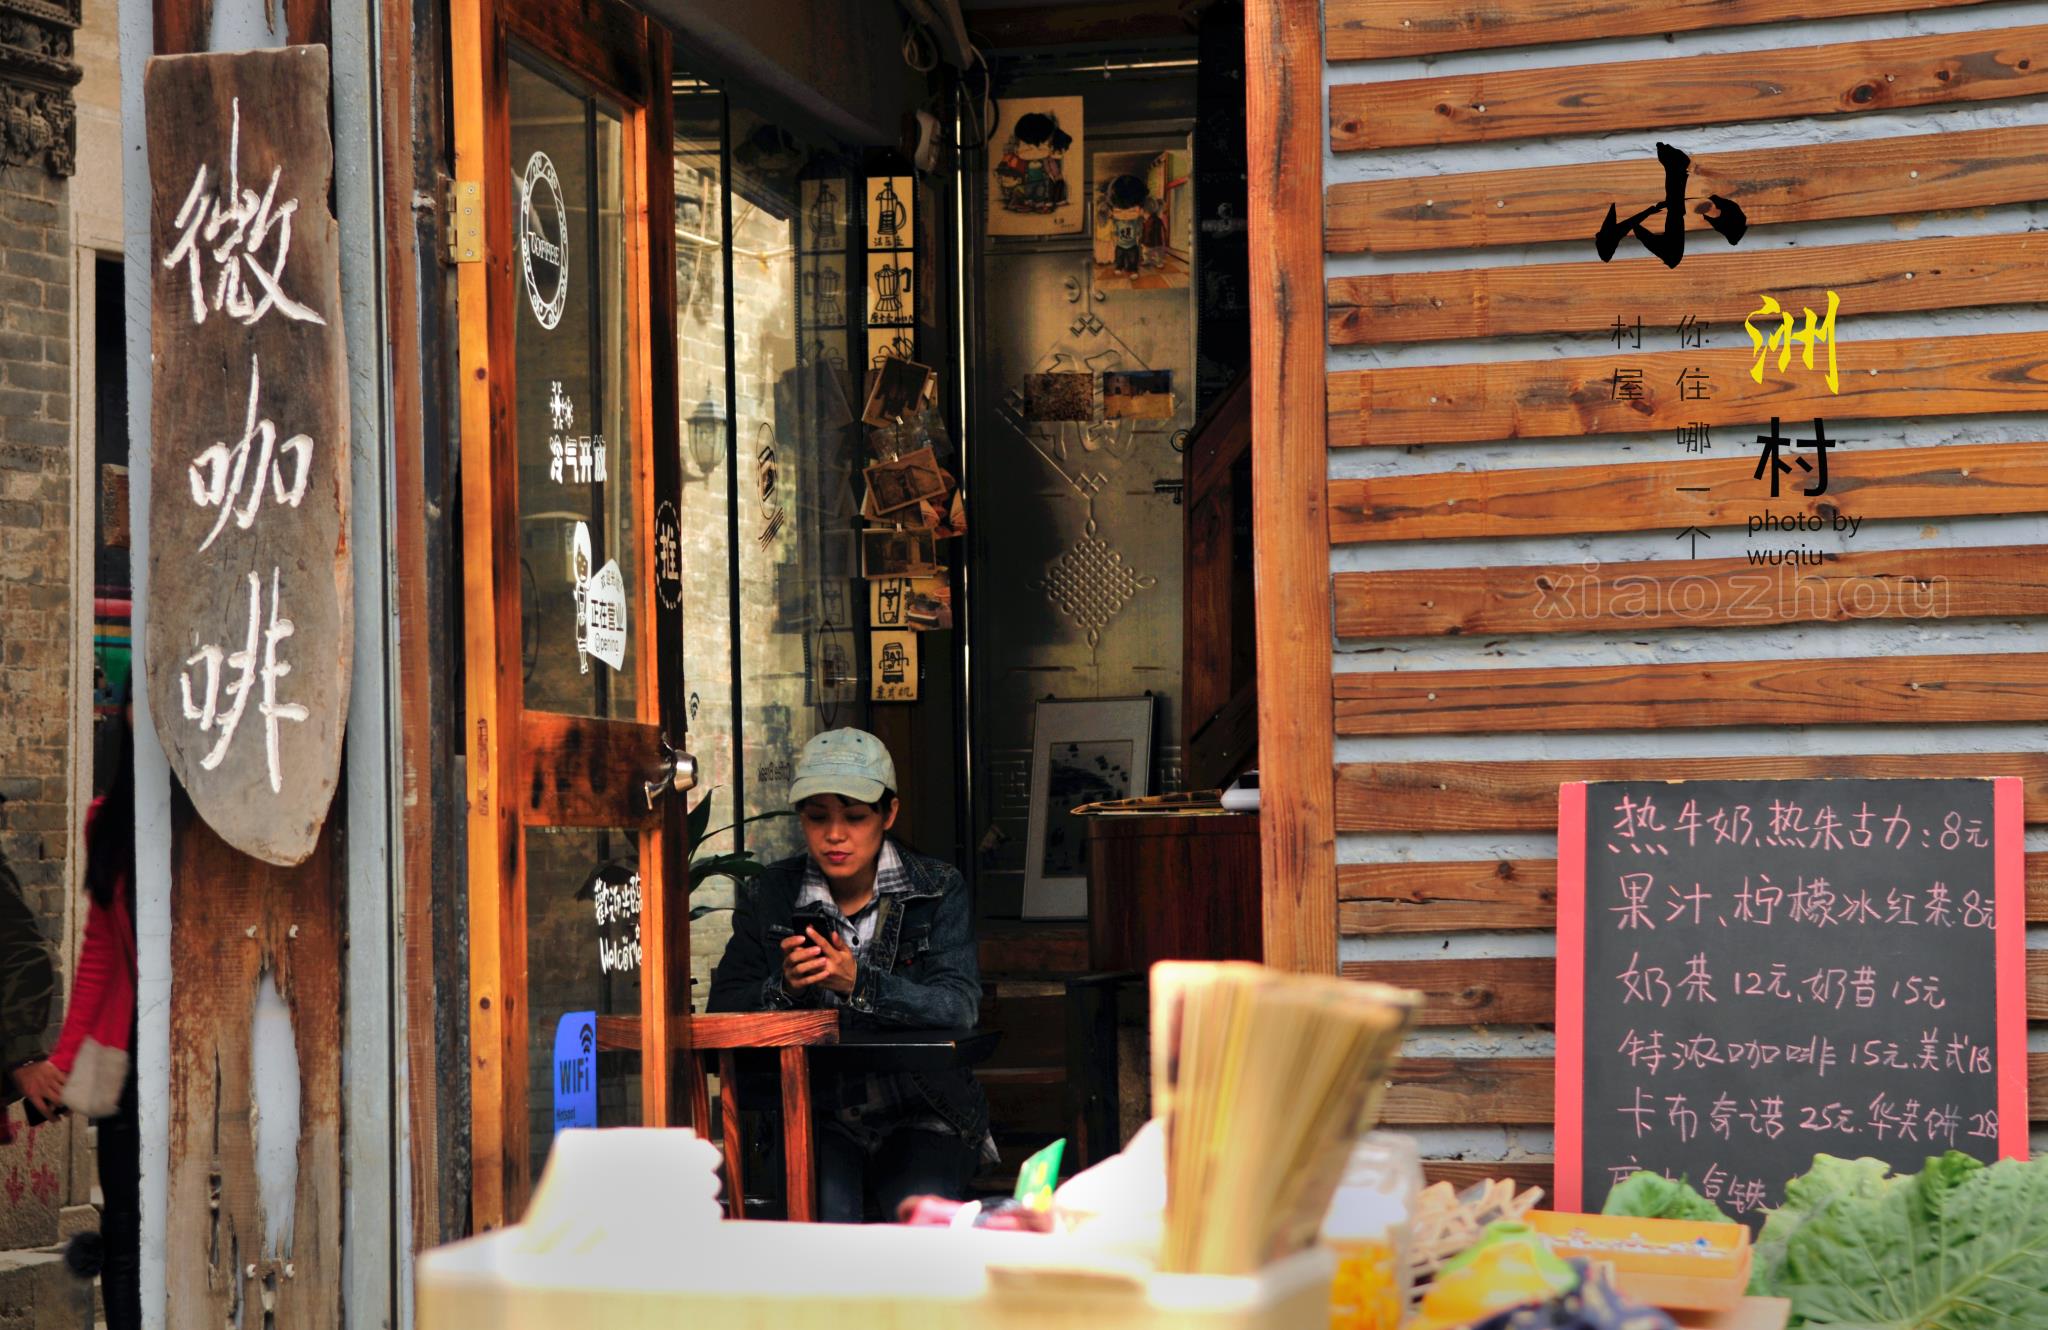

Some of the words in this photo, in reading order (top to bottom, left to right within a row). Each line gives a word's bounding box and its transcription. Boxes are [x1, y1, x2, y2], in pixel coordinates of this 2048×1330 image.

[528, 231, 560, 267] COFFEE
[163, 97, 327, 794] 微咖啡
[660, 523, 679, 580] 推
